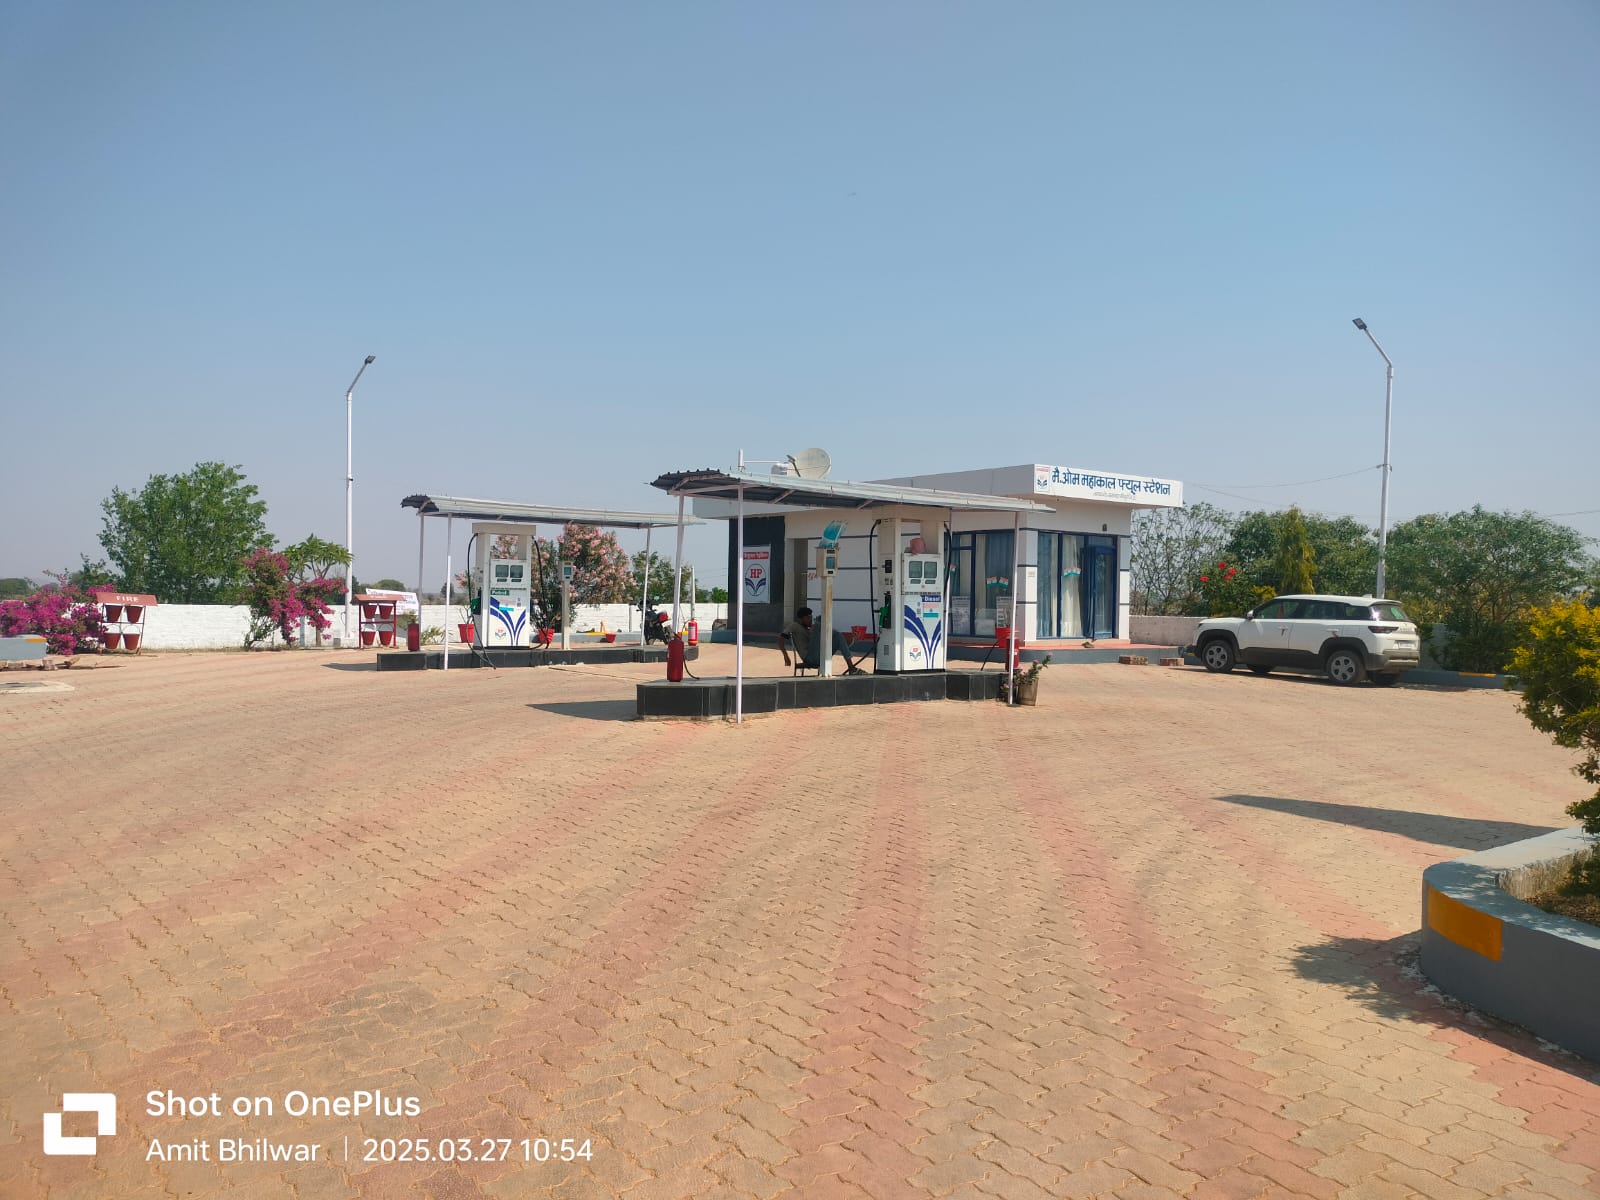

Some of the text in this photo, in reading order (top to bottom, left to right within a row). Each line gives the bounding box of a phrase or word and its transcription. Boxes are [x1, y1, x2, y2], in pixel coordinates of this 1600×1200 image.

[1081, 473, 1116, 489] महाकाल
[1118, 478, 1141, 495] फ्यूल
[1143, 478, 1171, 496] स्टेशन
[750, 568, 763, 579] HP
